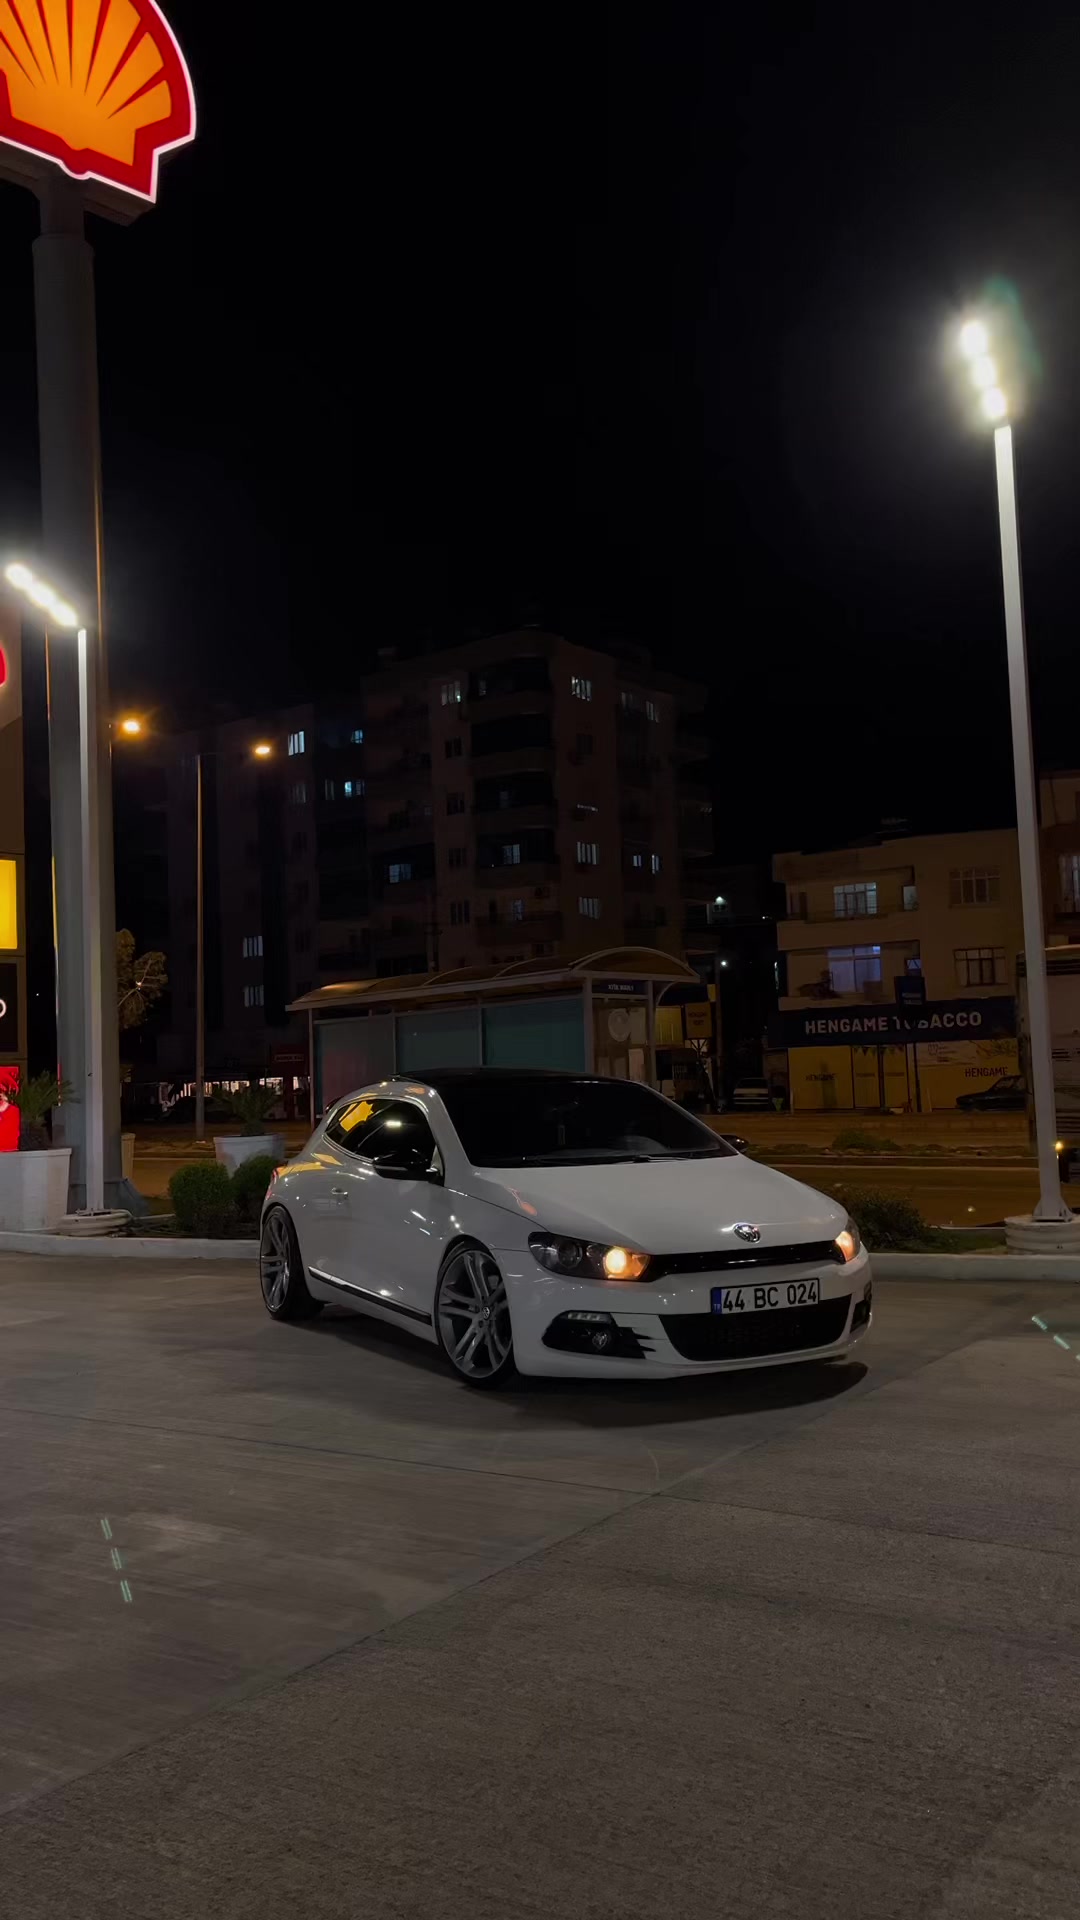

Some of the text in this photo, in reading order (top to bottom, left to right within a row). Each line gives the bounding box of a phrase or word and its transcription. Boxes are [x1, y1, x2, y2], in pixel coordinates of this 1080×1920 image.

[805, 1017, 888, 1035] HENGAME
[965, 1067, 1008, 1078] HENGAME
[723, 1282, 817, 1311] 44 BC 024
